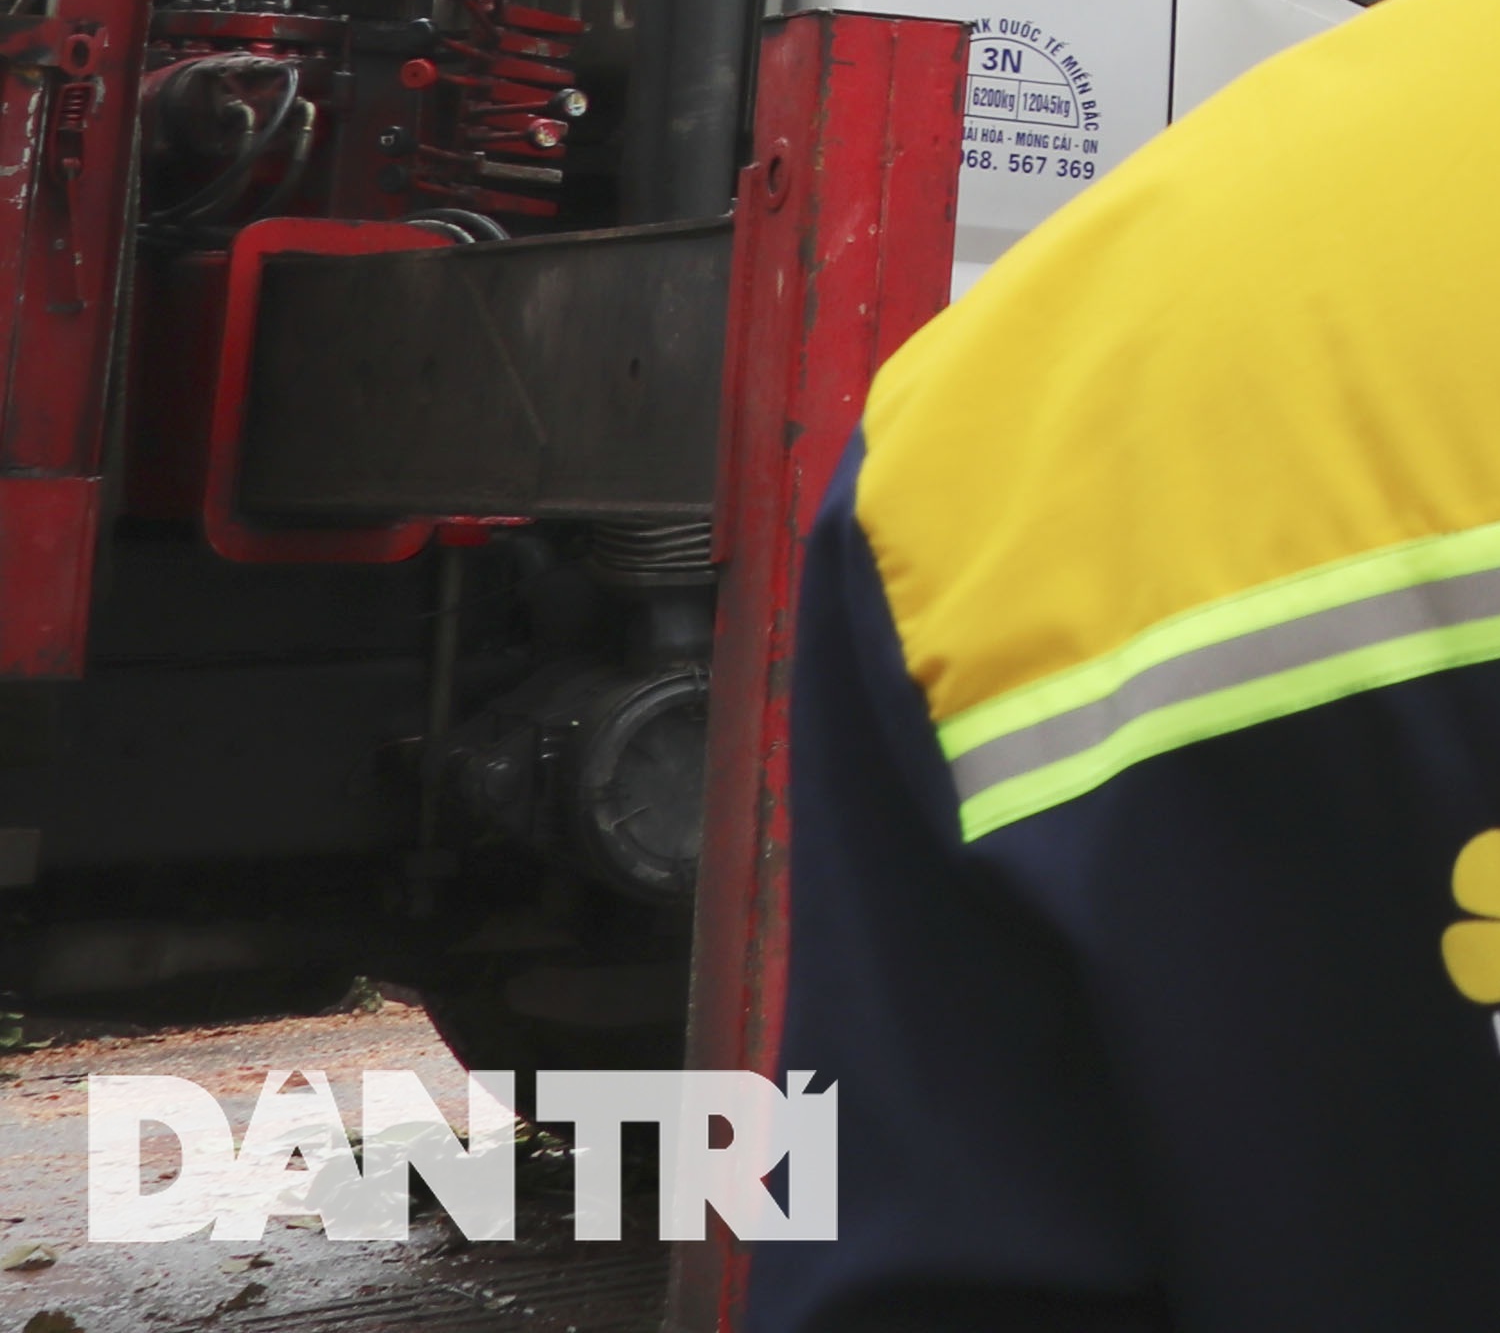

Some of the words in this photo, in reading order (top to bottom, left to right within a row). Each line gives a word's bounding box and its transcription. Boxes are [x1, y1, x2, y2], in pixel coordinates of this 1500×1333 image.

[981, 47, 1022, 73] 3N
[972, 86, 1016, 112] 6200kg
[1008, 153, 1047, 175] 567
[1056, 158, 1095, 180] 369
